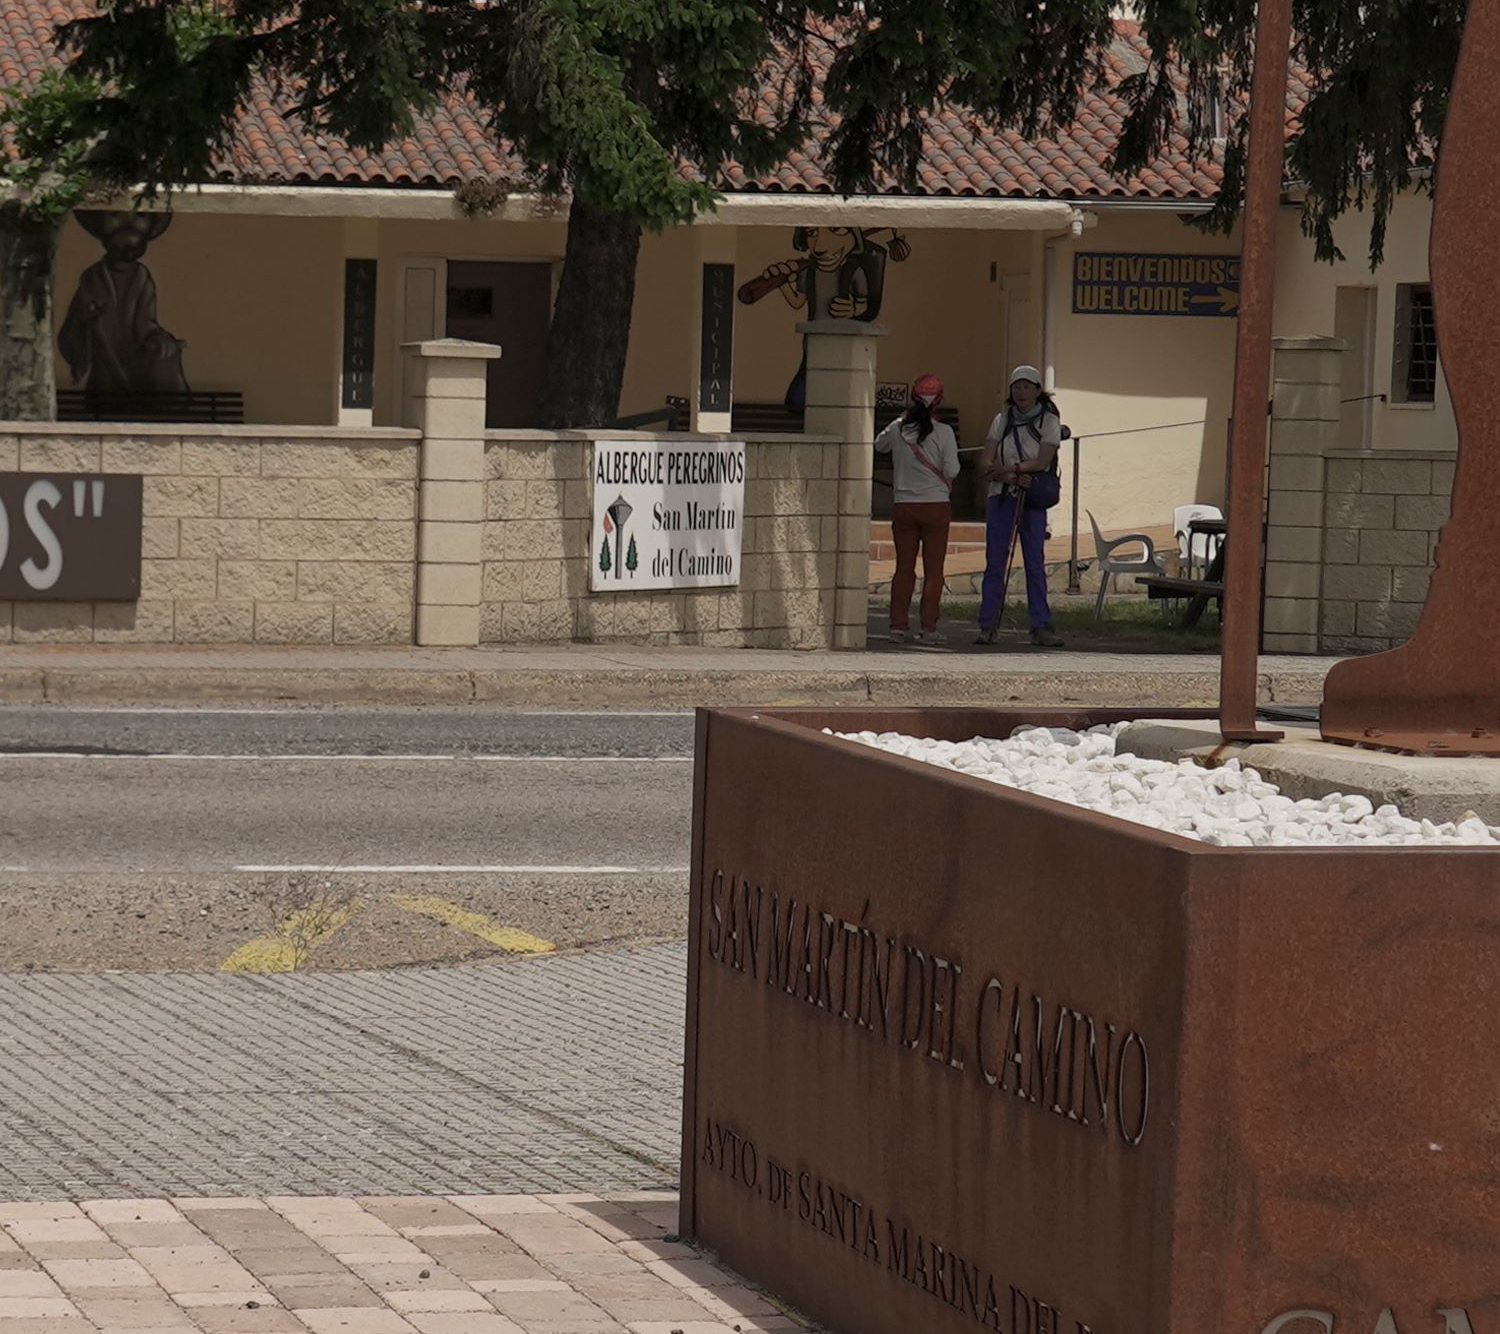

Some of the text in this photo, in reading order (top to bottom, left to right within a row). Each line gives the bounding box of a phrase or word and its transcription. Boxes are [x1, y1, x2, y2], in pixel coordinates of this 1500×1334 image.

[1077, 255, 1226, 284] BIENVENIDOS
[1076, 285, 1190, 312] WELCOME
[709, 269, 726, 405] MUNICIPAL
[596, 451, 744, 485] ALBERGUE PEREGRINOS
[652, 501, 681, 531] San
[652, 547, 732, 578] del Camino
[708, 868, 764, 978] SAN
[900, 944, 964, 1071] DEL
[976, 978, 1151, 1147] CAMINO
[767, 1158, 794, 1212] DE
[798, 1170, 881, 1263] SANTA
[886, 1217, 1004, 1334] MARINA
